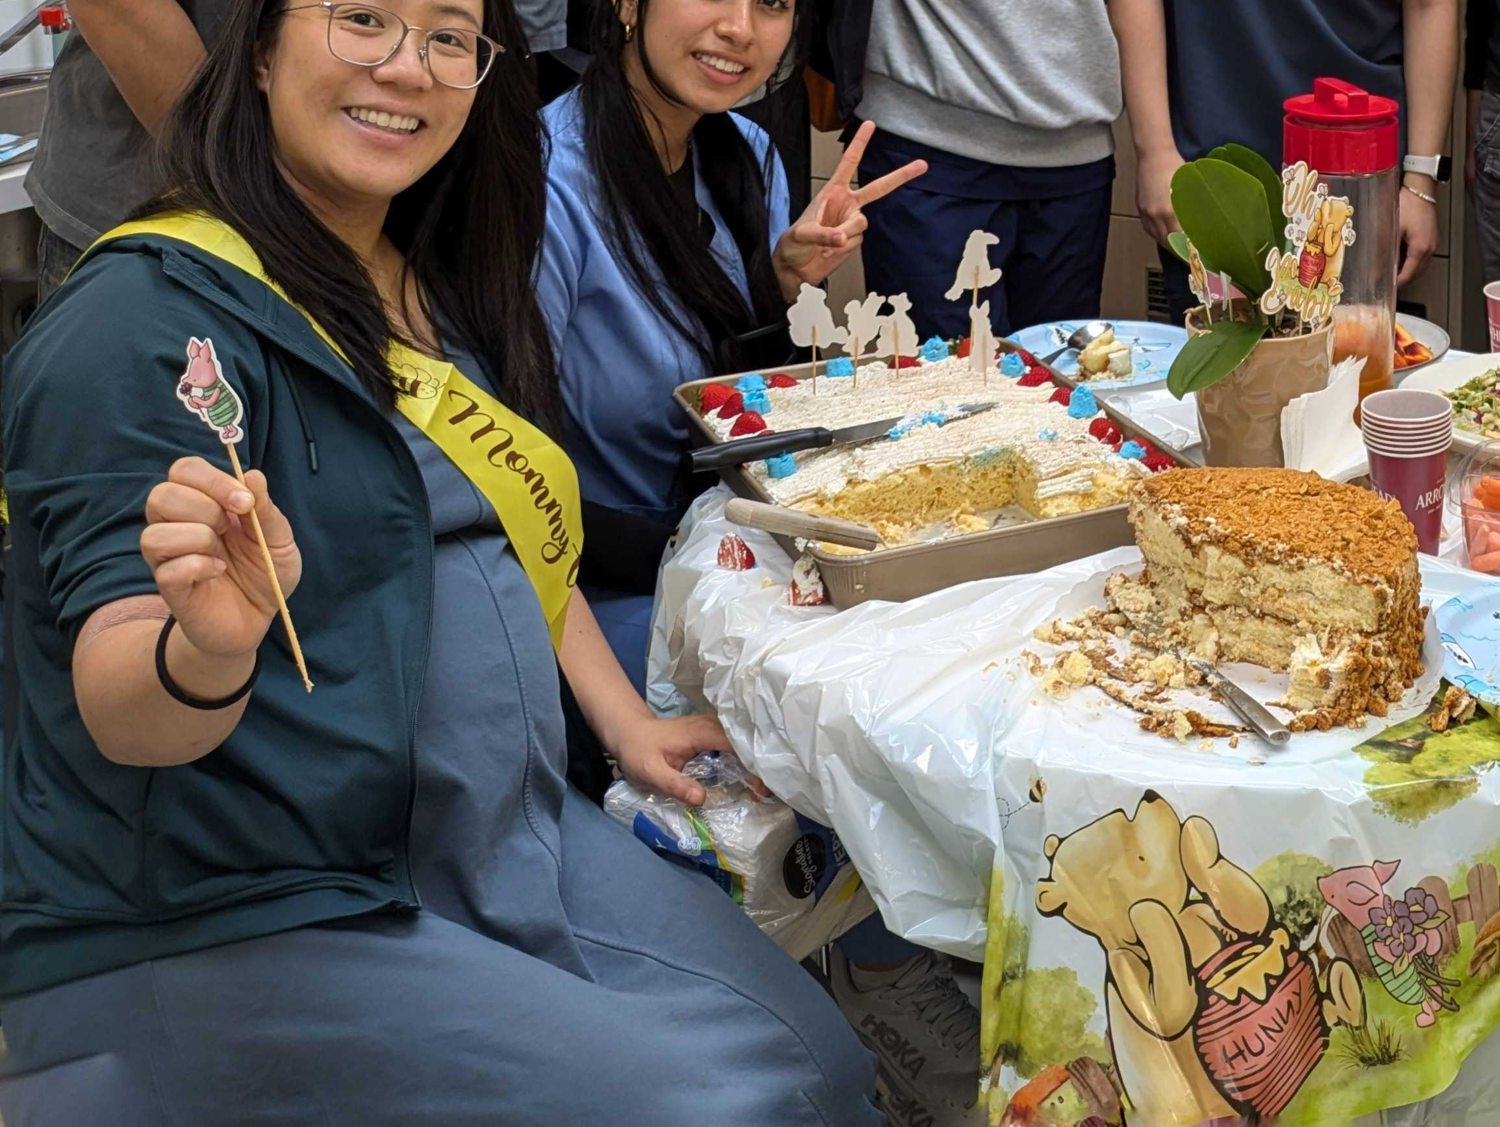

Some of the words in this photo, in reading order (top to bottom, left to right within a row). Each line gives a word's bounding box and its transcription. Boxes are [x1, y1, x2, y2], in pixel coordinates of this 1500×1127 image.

[447, 388, 570, 565] Mommy
[795, 840, 818, 894] Signature
[860, 1013, 928, 1081] HOKA
[1221, 978, 1302, 1070] HUNNY
